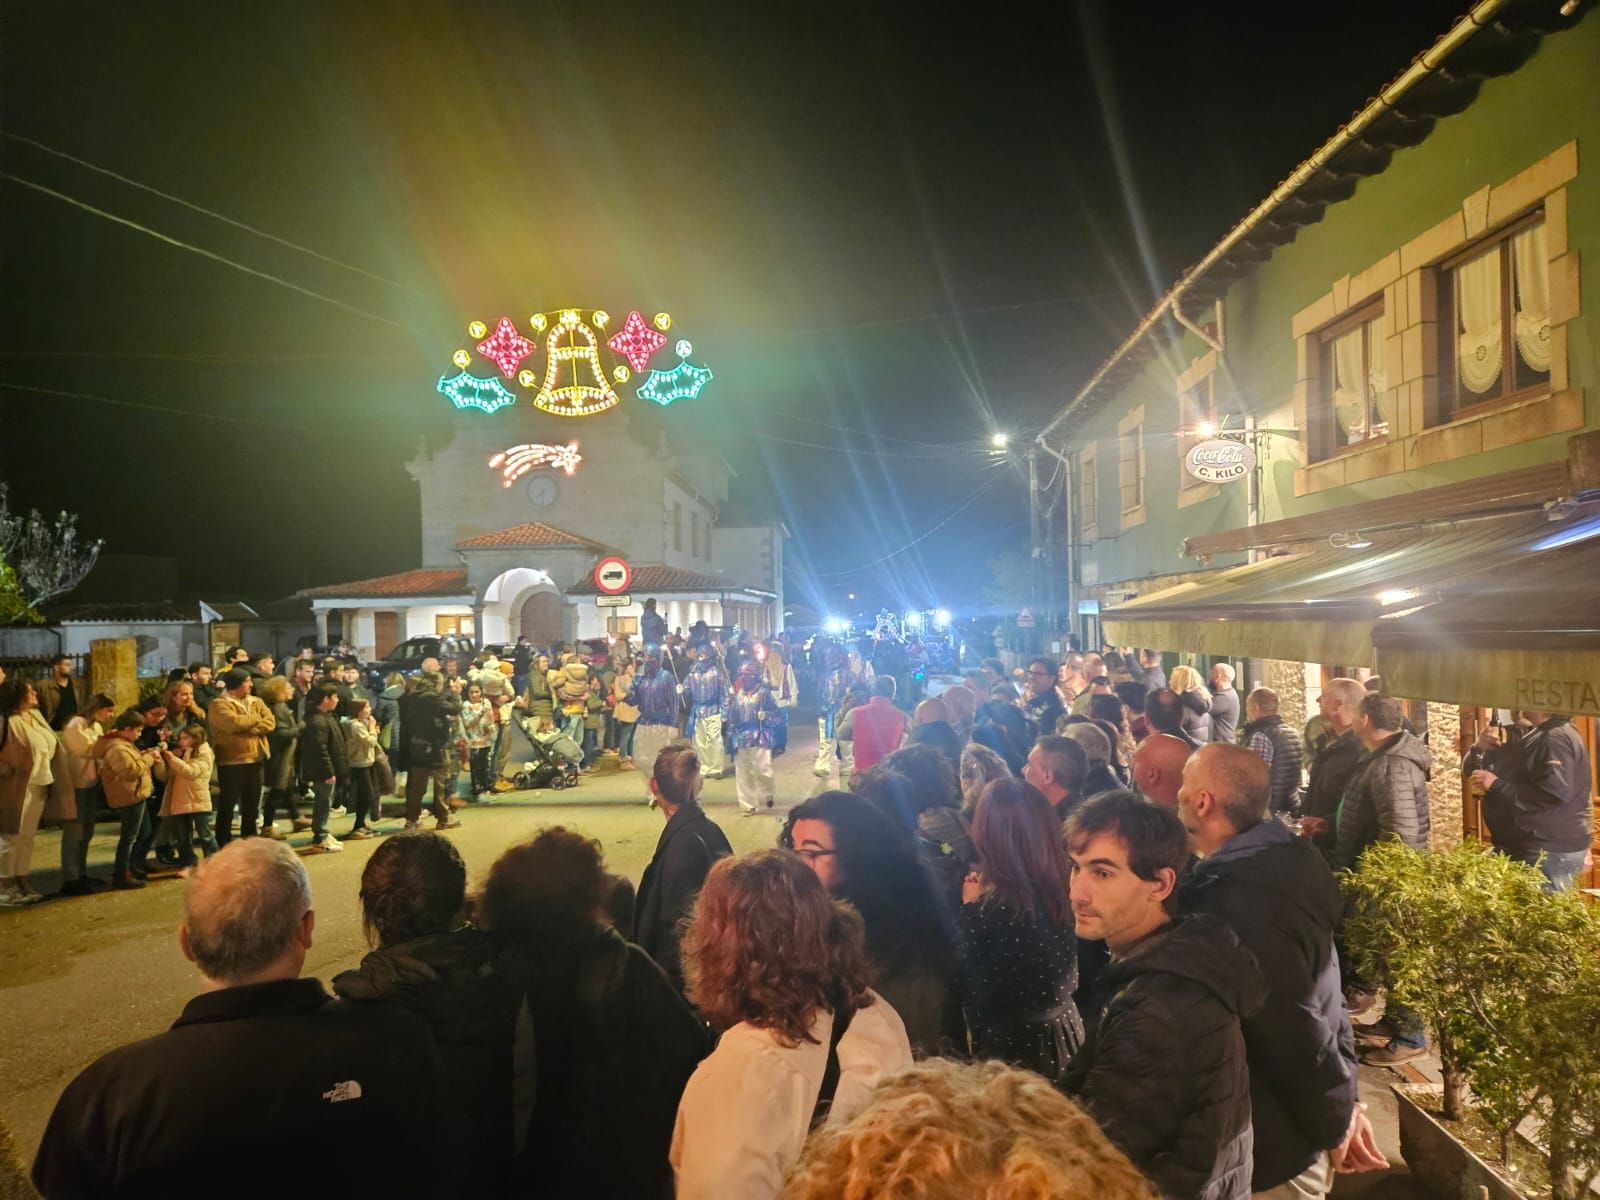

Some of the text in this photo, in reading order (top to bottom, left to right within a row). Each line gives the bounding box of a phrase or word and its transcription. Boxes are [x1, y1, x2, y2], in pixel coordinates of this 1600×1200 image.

[1192, 447, 1245, 465] Coca-Cola
[1199, 465, 1244, 478] C. KILO
[1515, 678, 1600, 711] RESTA
